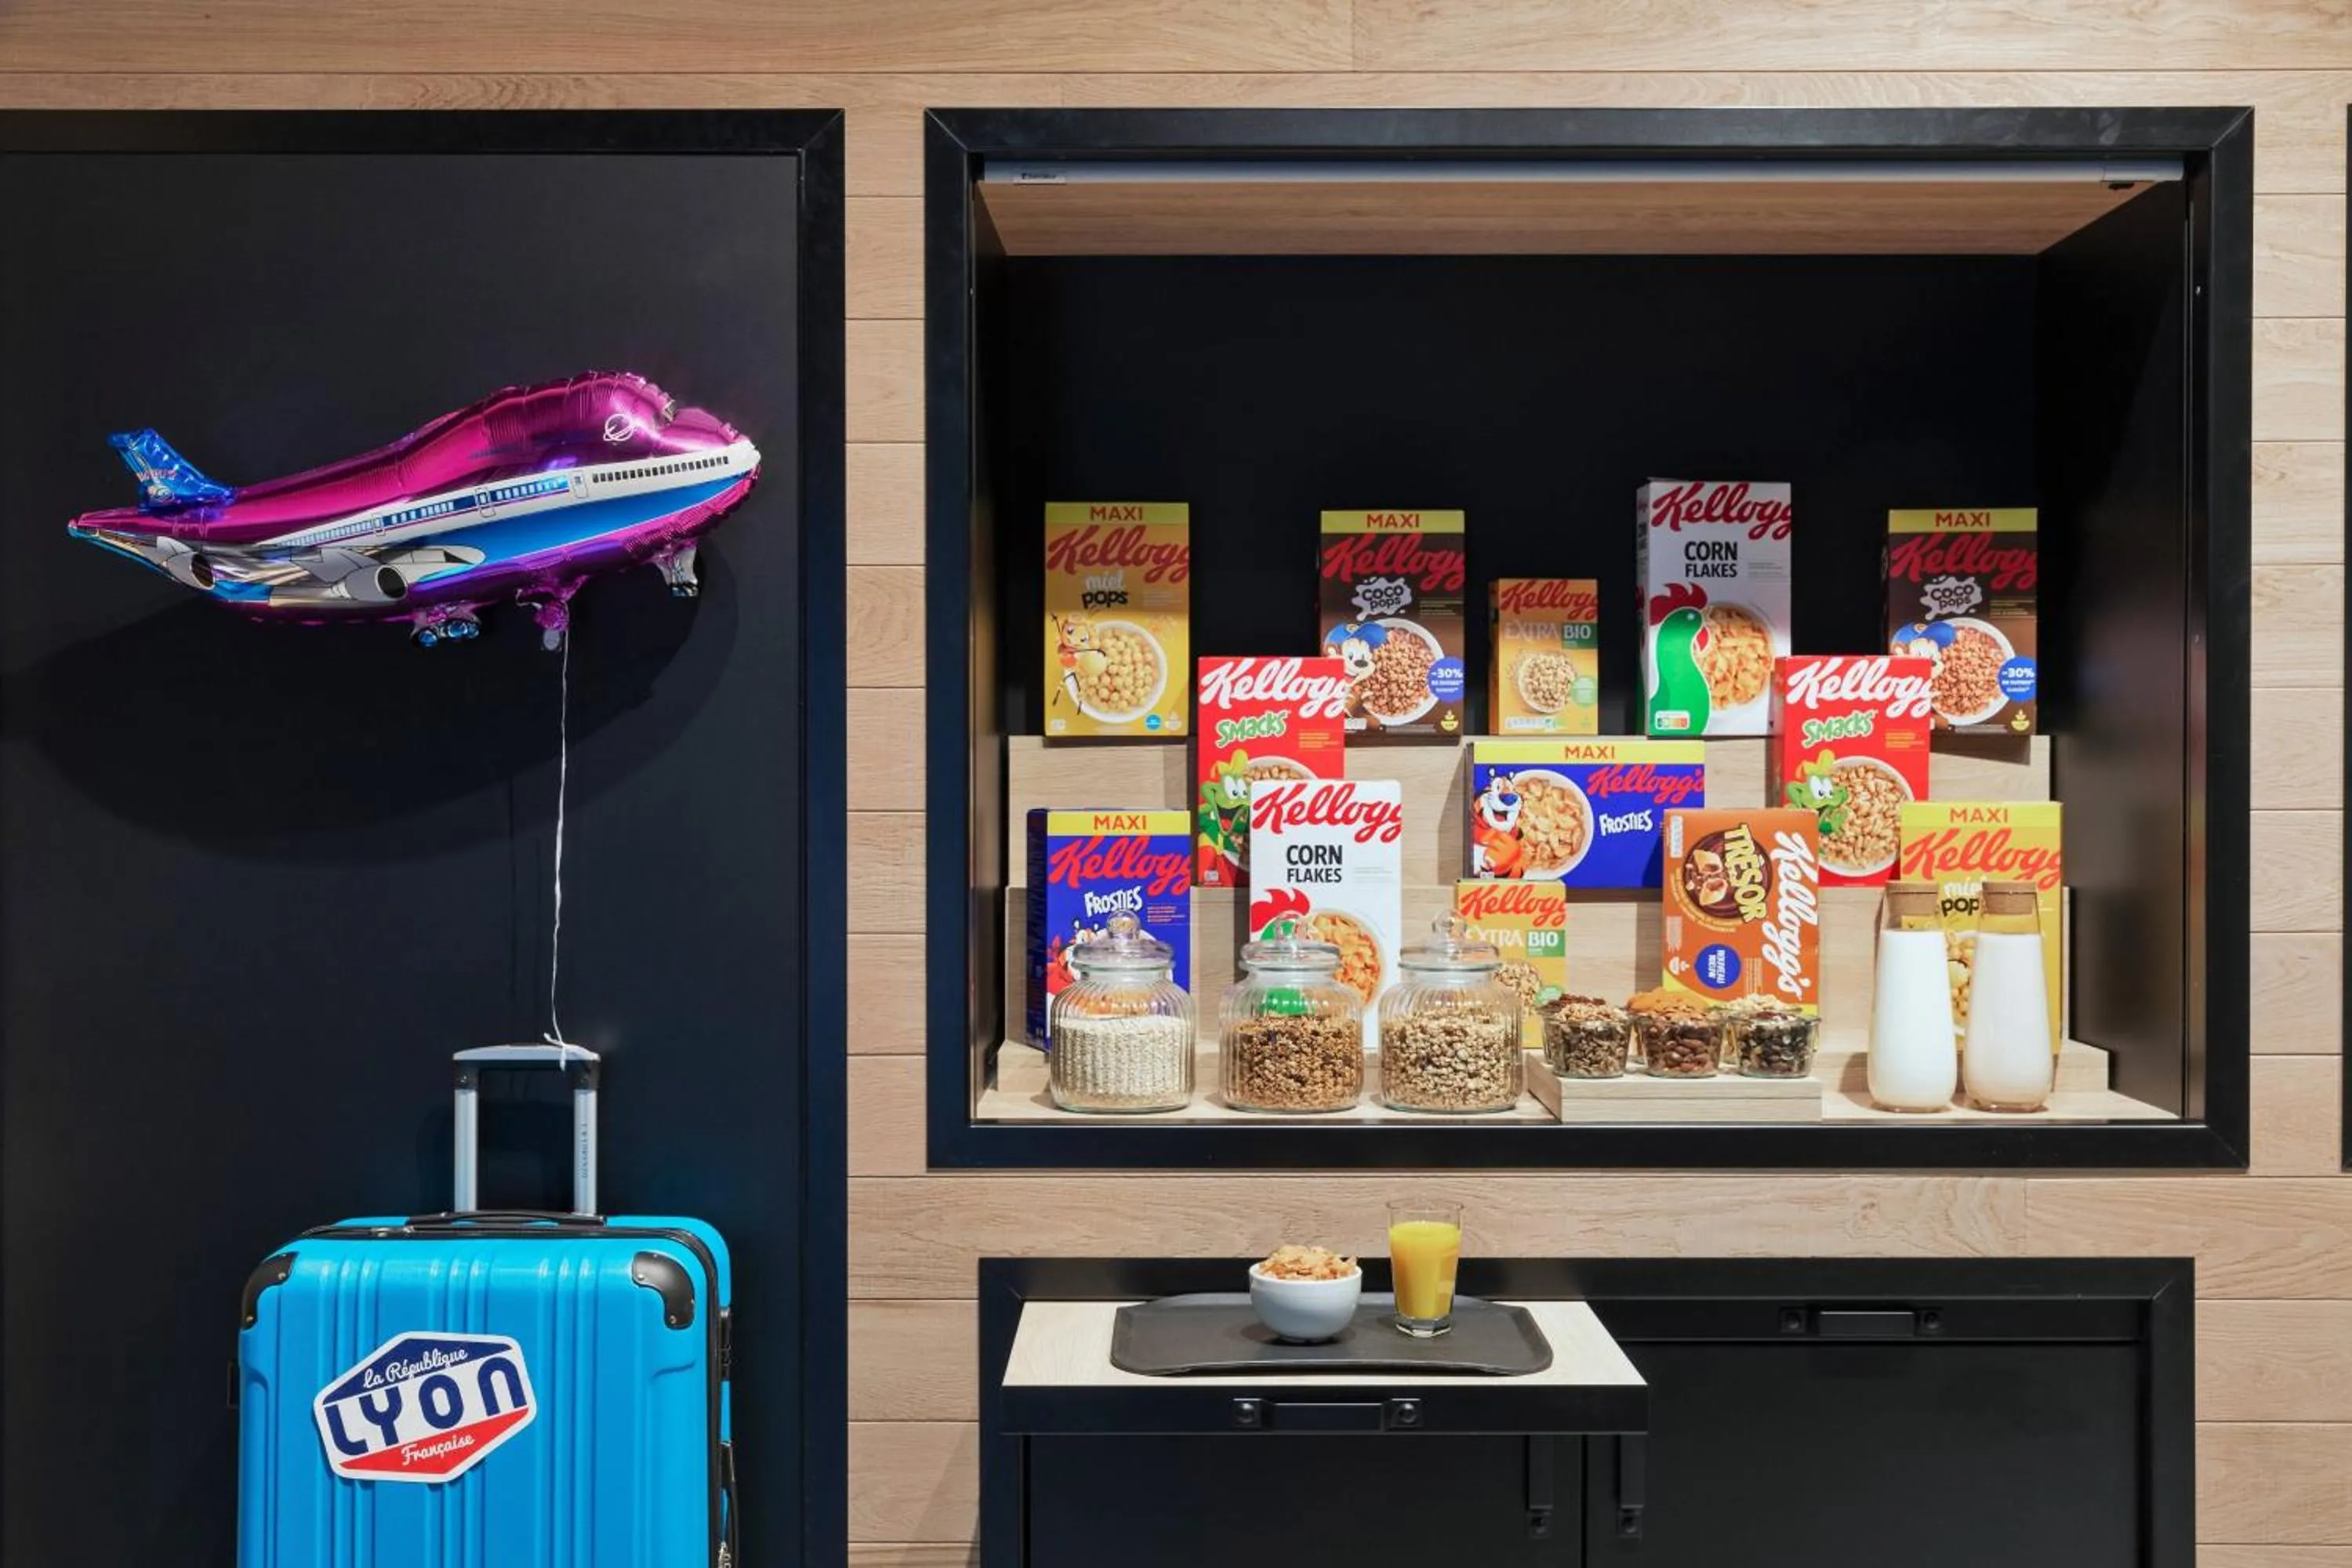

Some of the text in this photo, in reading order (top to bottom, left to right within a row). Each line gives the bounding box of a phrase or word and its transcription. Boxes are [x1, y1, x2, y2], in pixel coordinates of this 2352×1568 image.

[1090, 506, 1143, 521] MAXI
[1367, 514, 1420, 528] MAXI
[1936, 512, 1990, 527] MAXI
[1684, 541, 1738, 561] CORN
[1685, 562, 1738, 578] FLAKES
[1081, 591, 1129, 608] pops
[1370, 597, 1402, 612] pops
[1939, 594, 1971, 610] pops
[1504, 620, 1592, 640] EXTRA BIO
[1432, 668, 1464, 679] -30%
[2002, 667, 2035, 678] -30%
[1564, 746, 1615, 760] MAXI
[1587, 763, 1705, 804] Kellogg's
[1093, 815, 1146, 830] MAXI
[1599, 810, 1653, 836] FROSTIES
[1950, 808, 2009, 822] MAXI
[1287, 844, 1342, 866] CORN
[1287, 868, 1342, 884] FLAKES
[1083, 886, 1142, 917] FROSTIES
[1762, 831, 1818, 1000] Kellogg's
[1528, 931, 1559, 947] BIO
[385, 1348, 469, 1381] République
[401, 1433, 475, 1466] Française
